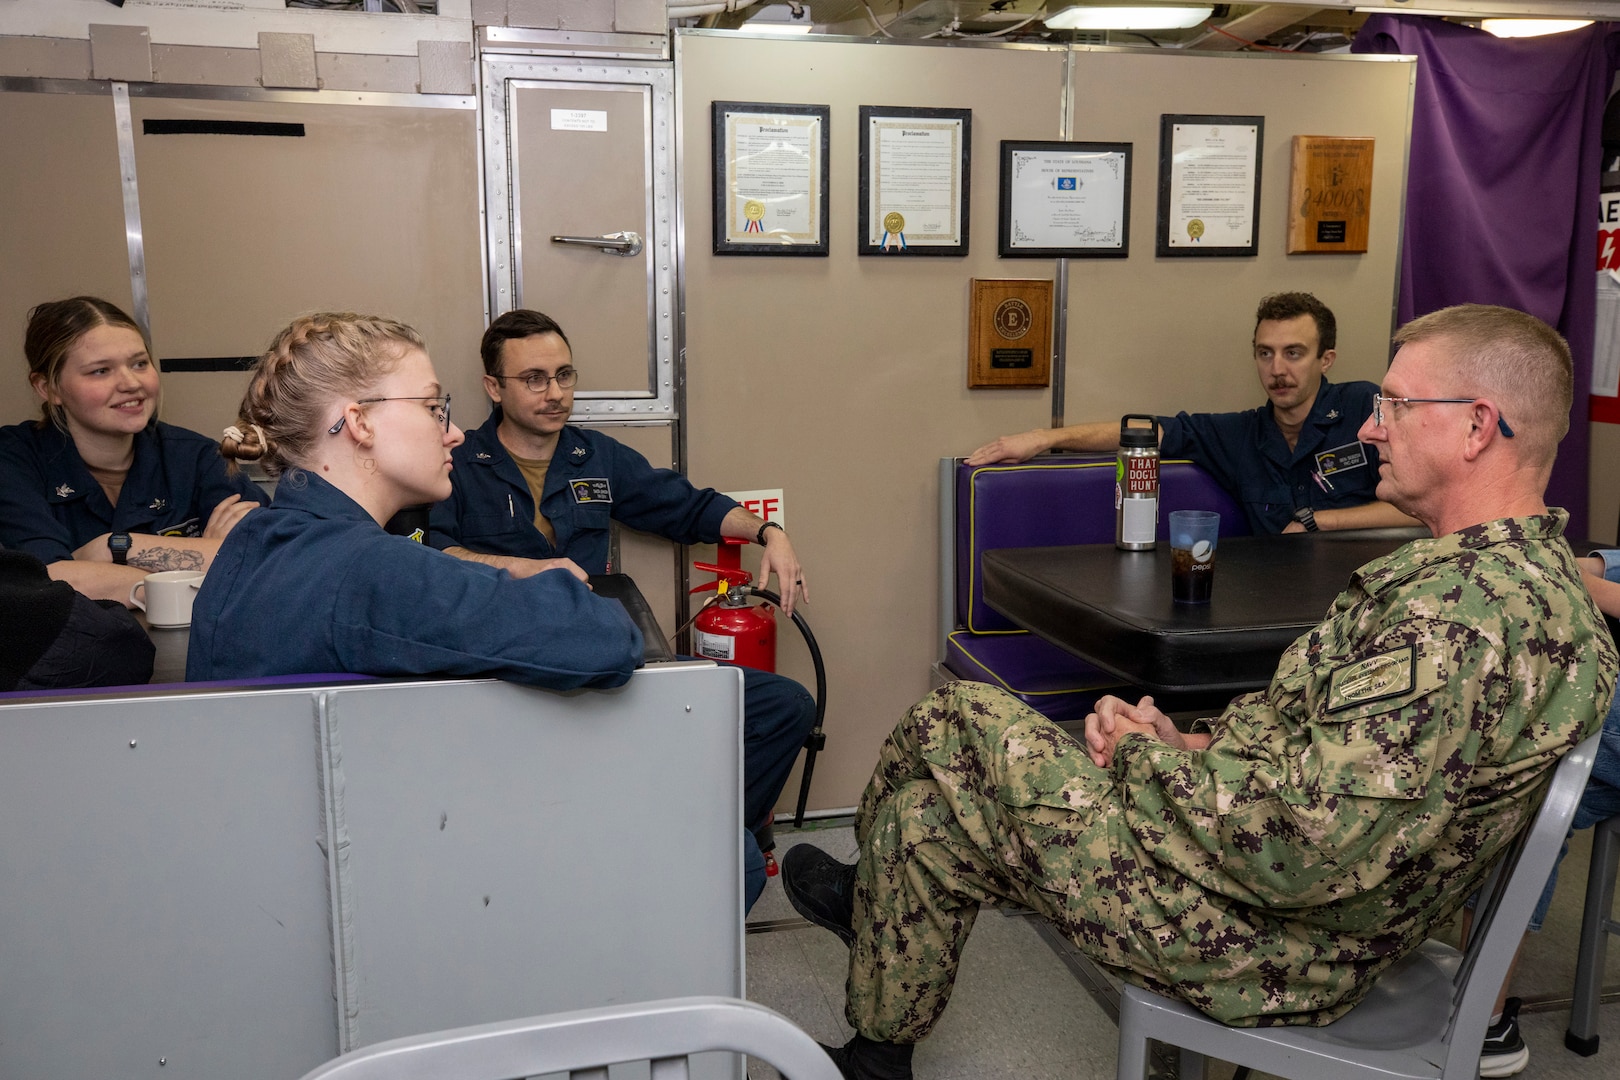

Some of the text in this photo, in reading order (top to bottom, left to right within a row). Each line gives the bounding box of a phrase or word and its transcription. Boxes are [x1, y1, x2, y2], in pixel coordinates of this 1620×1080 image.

[1312, 189, 1355, 208] 4000
[1004, 301, 1024, 309] BATTLE
[1007, 312, 1018, 327] E
[1130, 458, 1157, 469] THAT
[1129, 469, 1158, 480] DOG'LL
[1130, 480, 1157, 491] HUNT
[1191, 563, 1211, 571] pepsi
[1361, 658, 1378, 670] NAVY
[1374, 681, 1387, 690] SEA
